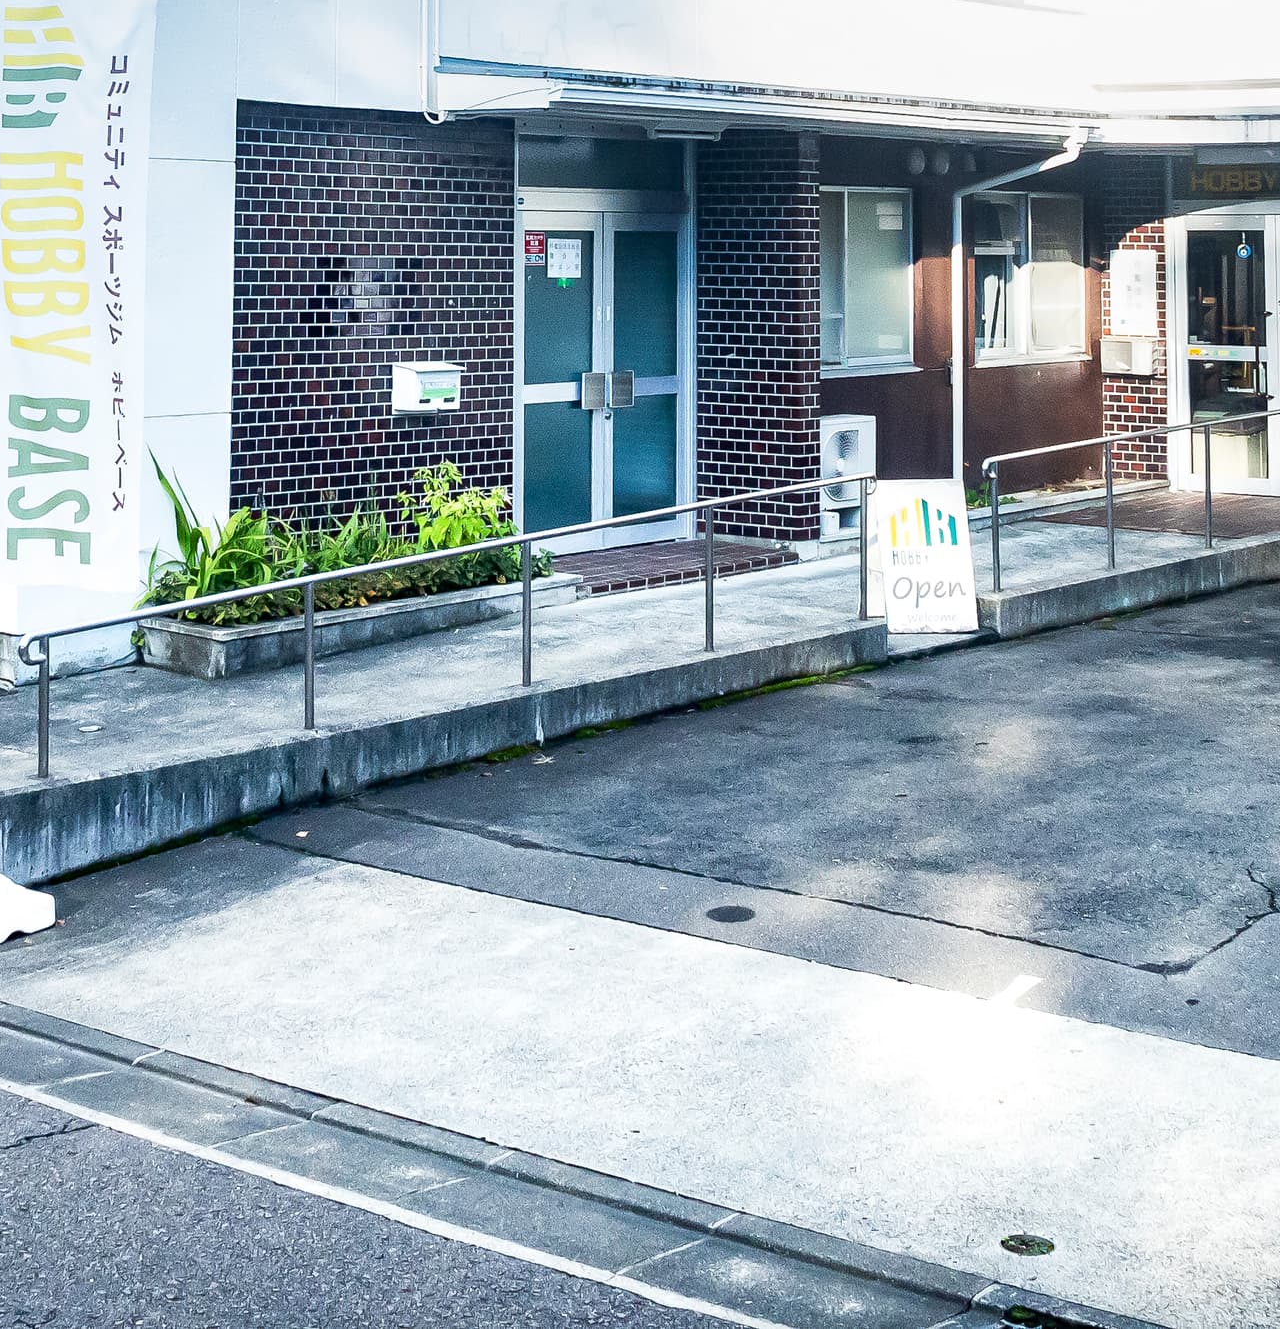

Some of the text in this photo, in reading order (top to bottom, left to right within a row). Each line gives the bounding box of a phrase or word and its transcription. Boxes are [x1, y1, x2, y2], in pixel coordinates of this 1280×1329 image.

[102, 55, 130, 512] コミュニティ スポーツジム ホビーベース
[1190, 170, 1280, 193] HOBBY
[0, 151, 91, 565] HOBBY BASE
[892, 576, 967, 609] Open
